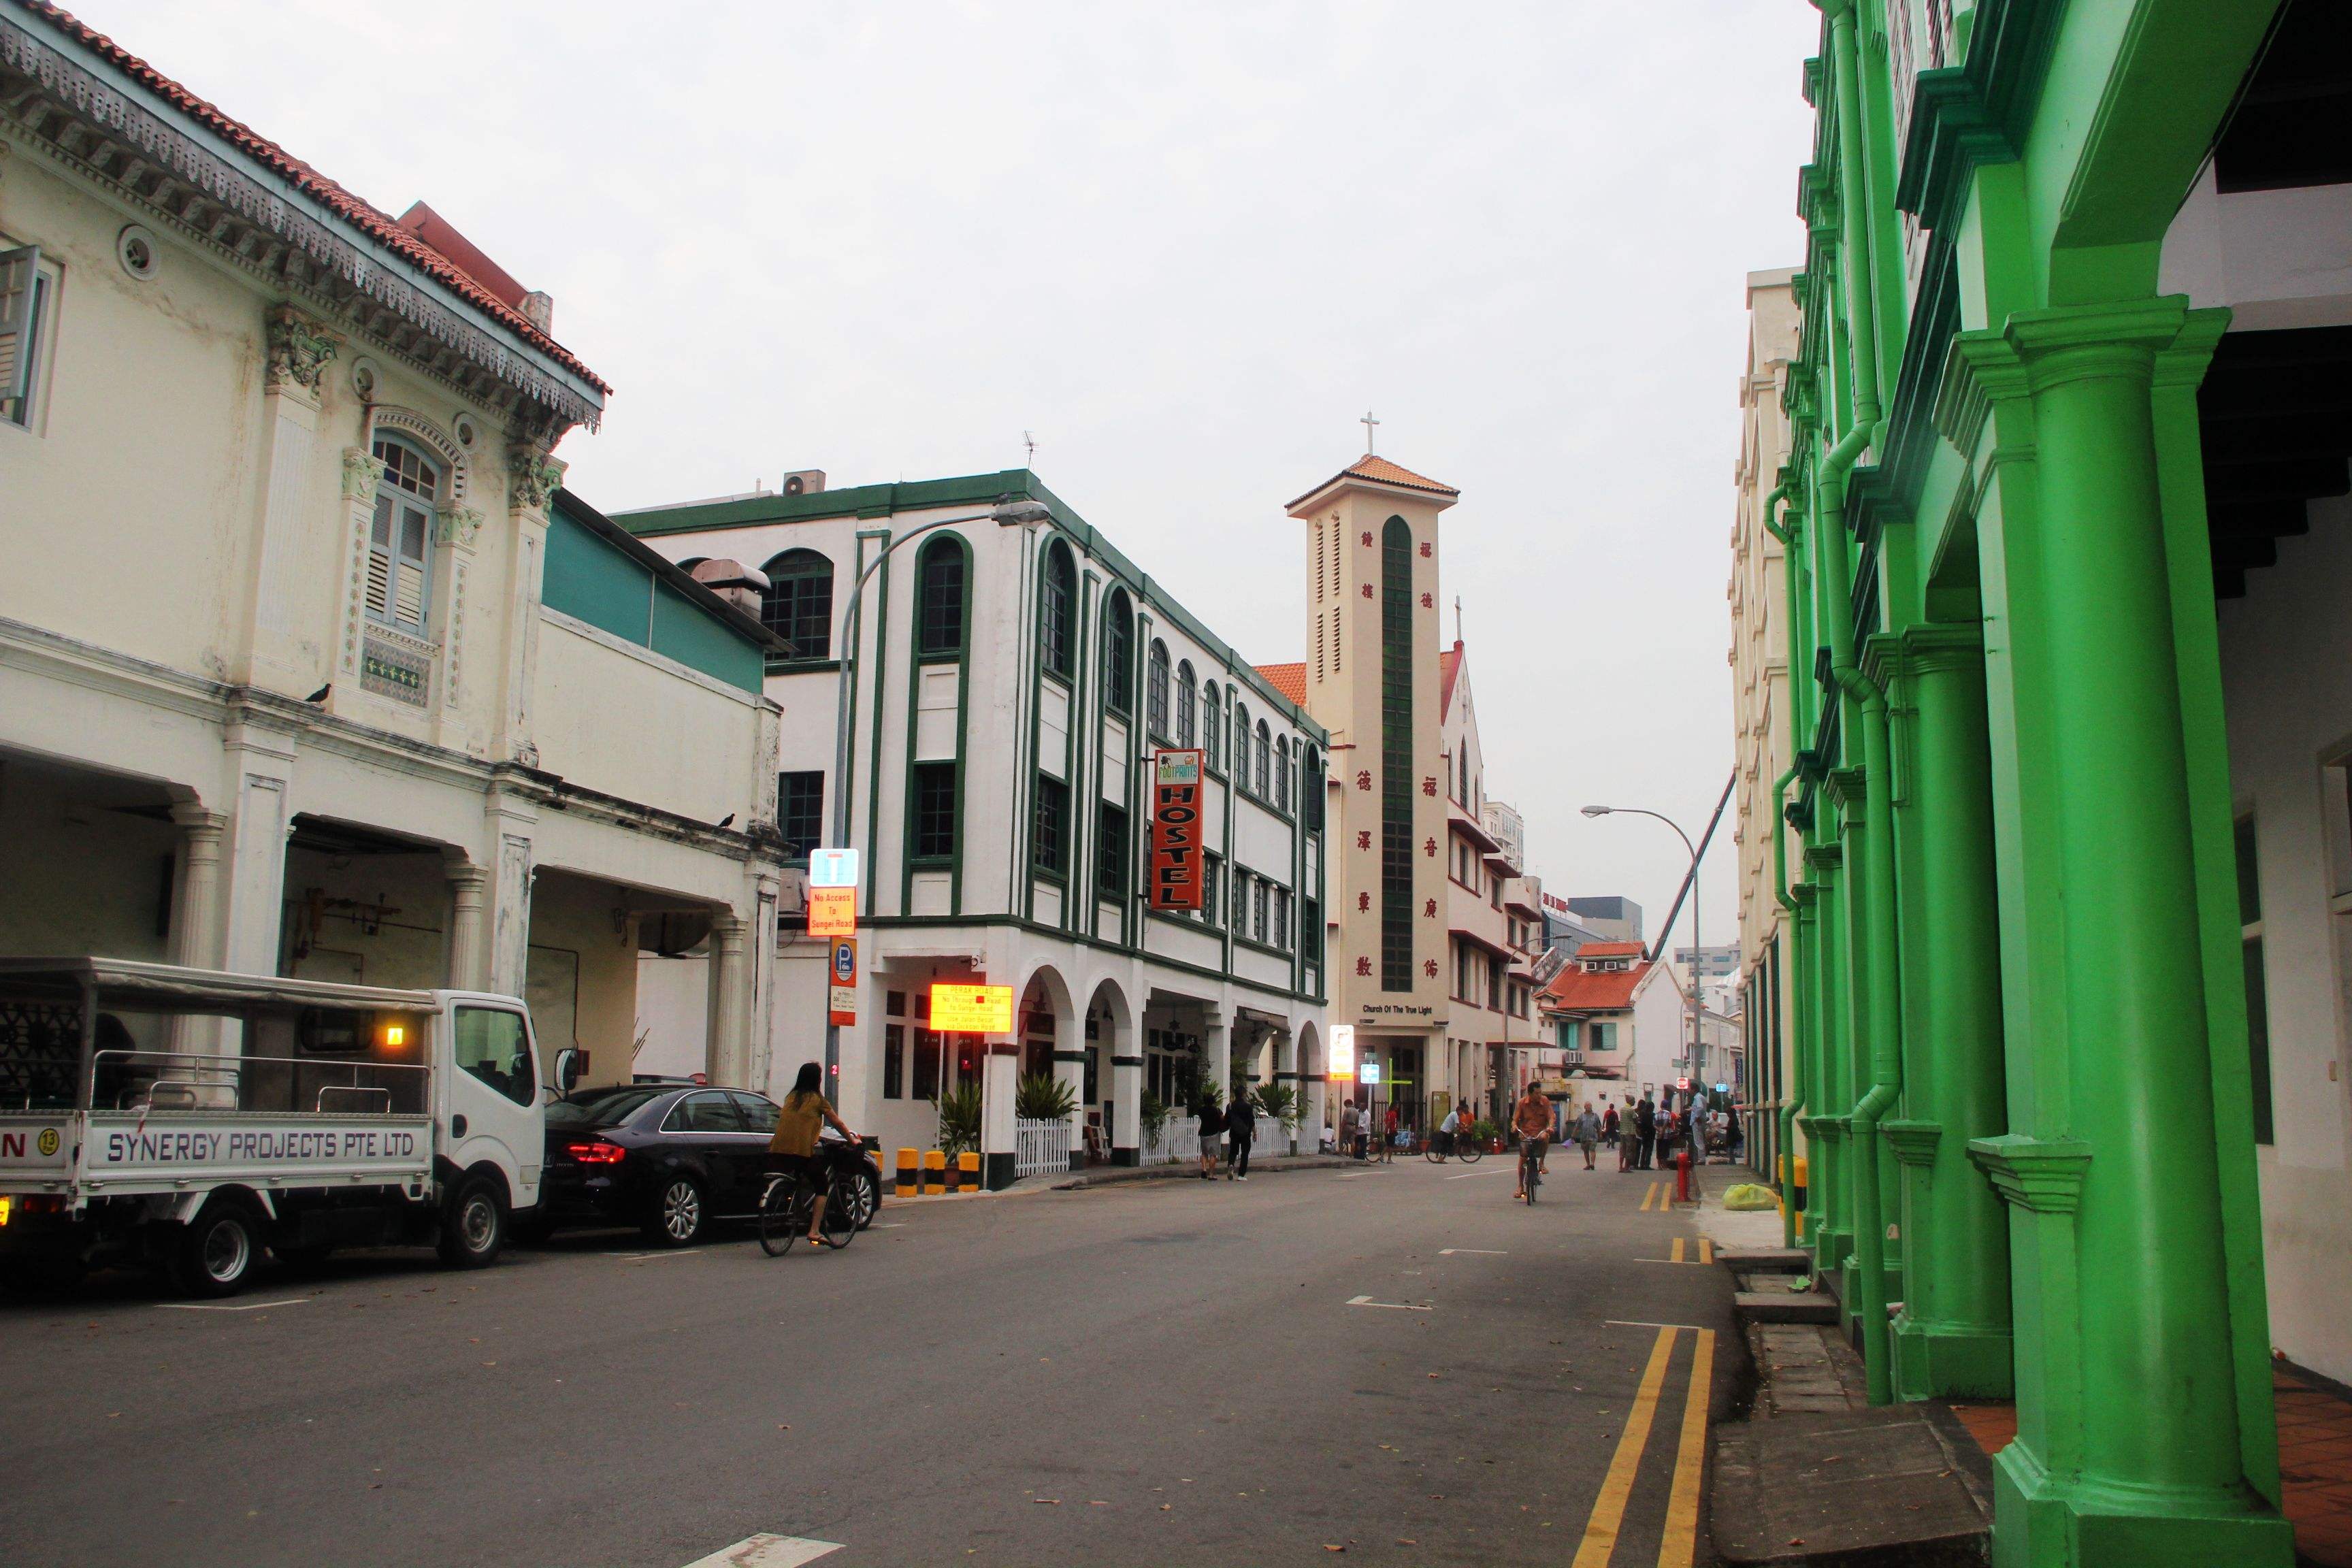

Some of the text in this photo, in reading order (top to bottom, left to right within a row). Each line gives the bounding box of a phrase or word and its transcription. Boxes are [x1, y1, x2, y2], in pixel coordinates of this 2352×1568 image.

[1159, 765, 1197, 778] FOOTPRINTS
[1158, 785, 1196, 905] HOSTEL
[815, 894, 850, 902] No Access
[828, 906, 836, 915] To
[812, 919, 852, 930] Sungei Road
[950, 986, 994, 995] PERAK ROAD
[1362, 1004, 1432, 1016] Church Of The True Light
[42, 1132, 55, 1145] 13
[108, 1133, 414, 1162] SYNERGY PROJECTS PTE LTD
